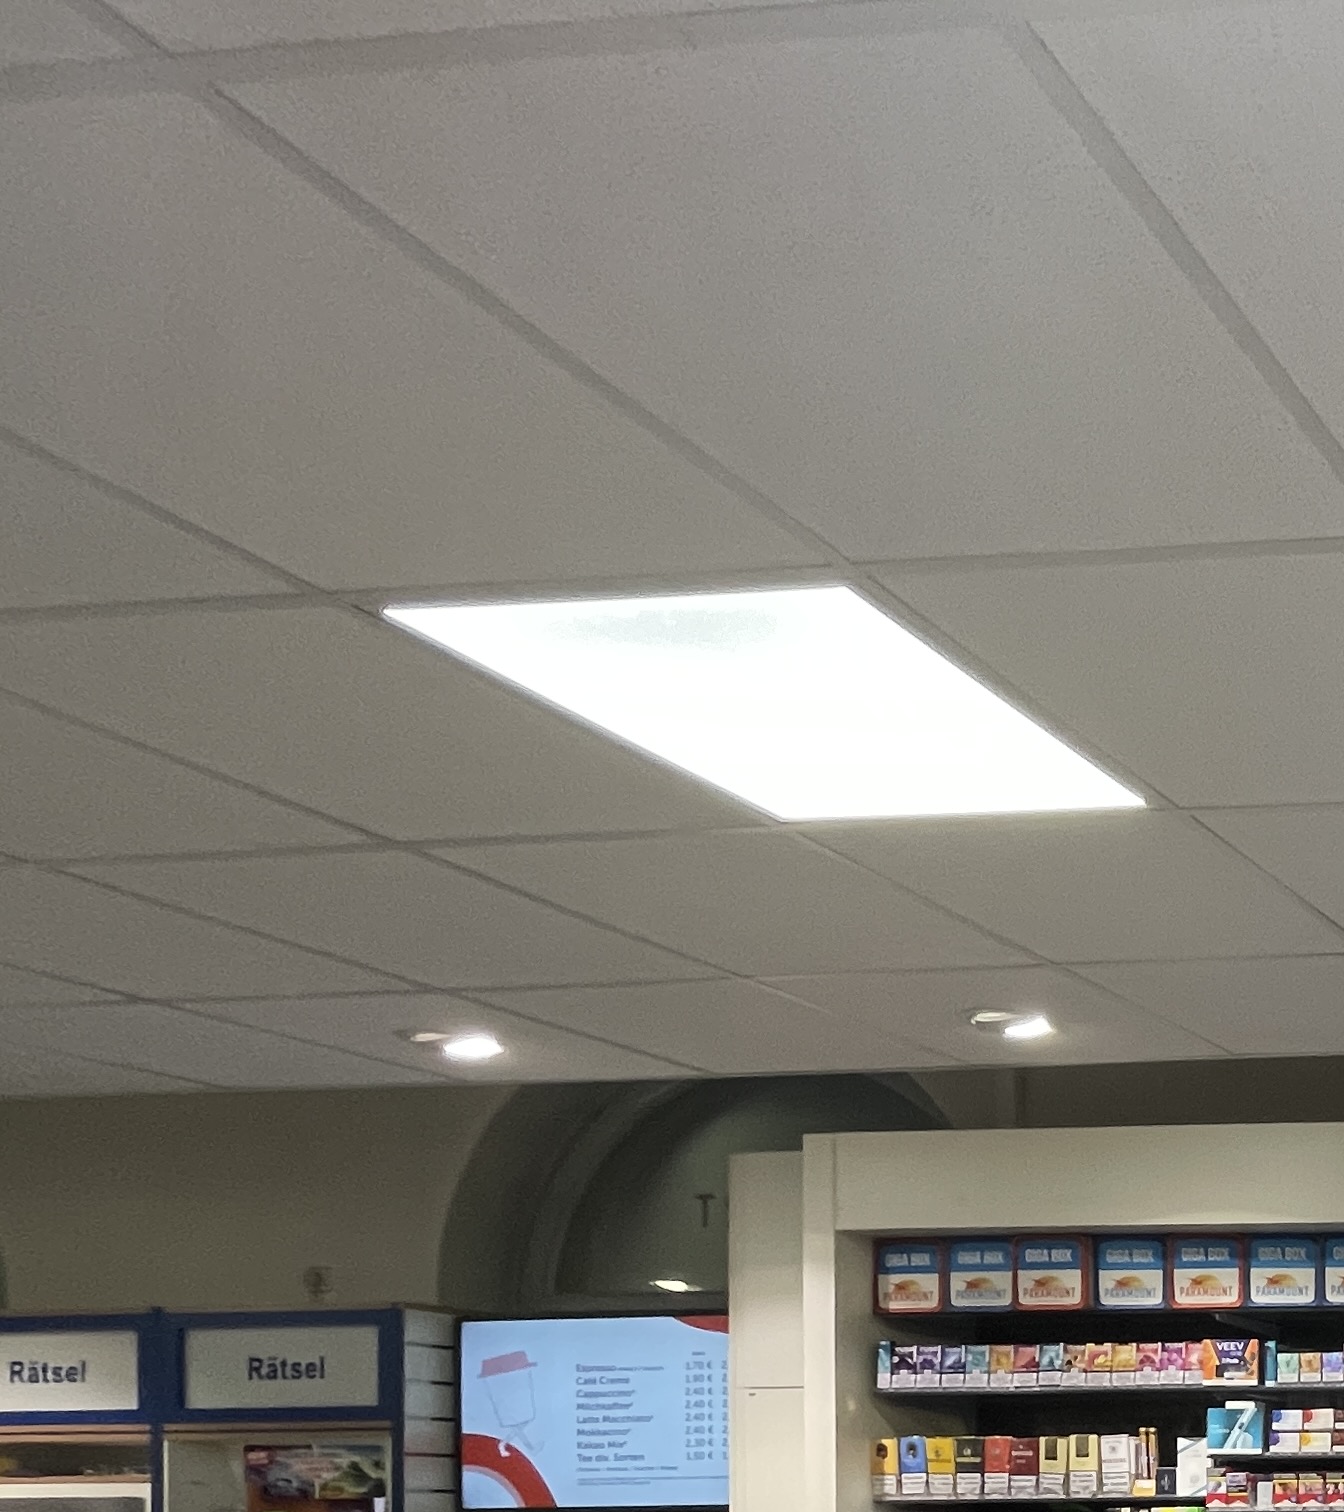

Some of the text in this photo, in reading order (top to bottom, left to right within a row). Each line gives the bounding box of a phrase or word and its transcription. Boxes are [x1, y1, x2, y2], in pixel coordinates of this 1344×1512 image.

[1216, 1342, 1244, 1350] VEEV
[9, 1361, 86, 1384] Rätsel
[248, 1356, 325, 1380] Rätsel
